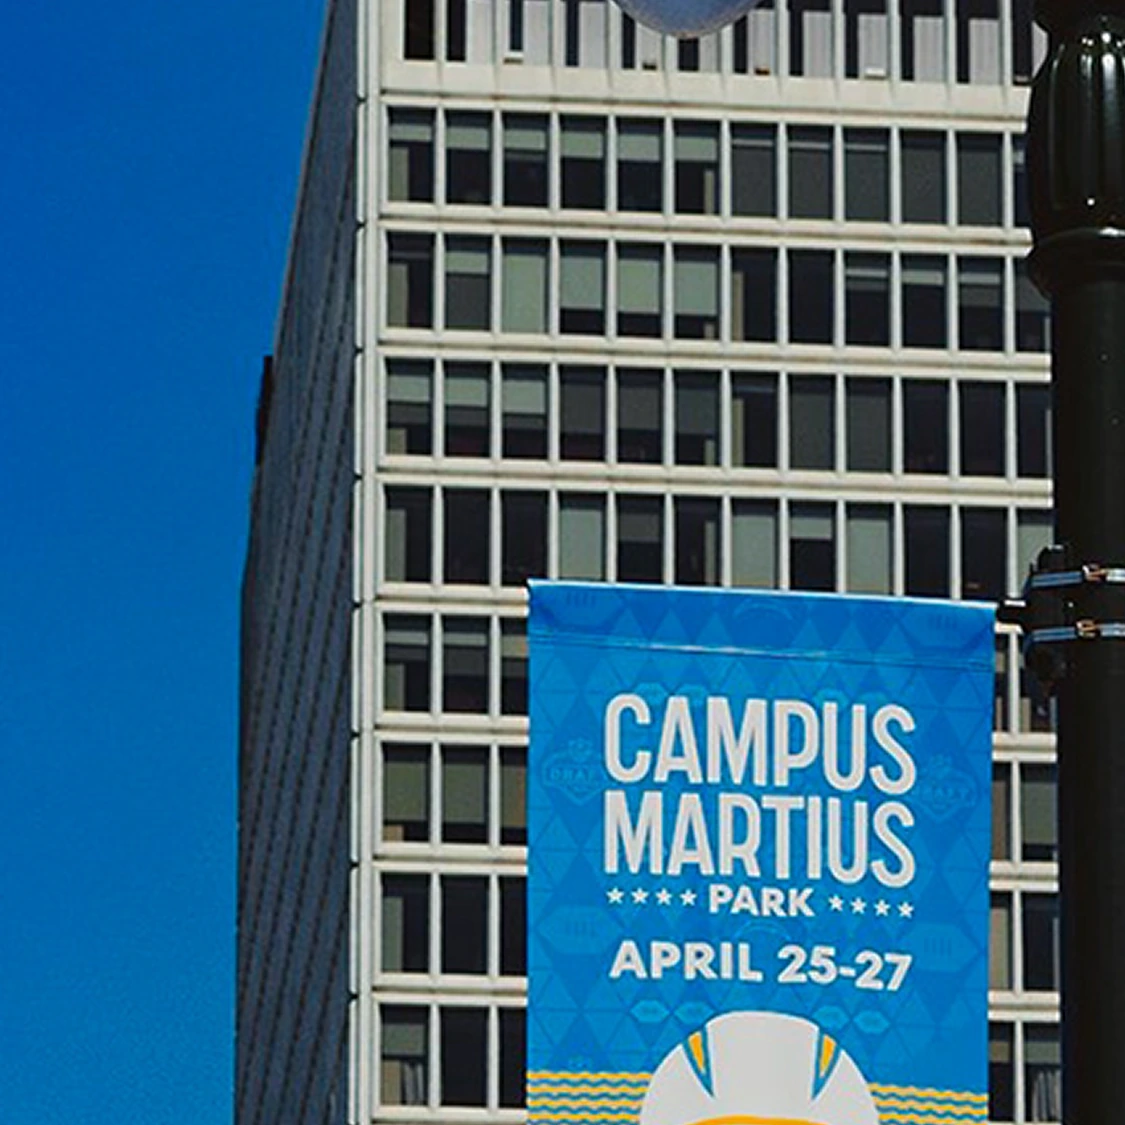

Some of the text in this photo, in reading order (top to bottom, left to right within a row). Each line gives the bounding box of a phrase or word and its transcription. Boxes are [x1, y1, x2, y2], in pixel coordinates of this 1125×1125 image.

[604, 693, 917, 795] CAMPUS
[604, 789, 917, 888] MARTIUS
[709, 883, 816, 918] PARK
[609, 940, 914, 991] APRIL 25-27
